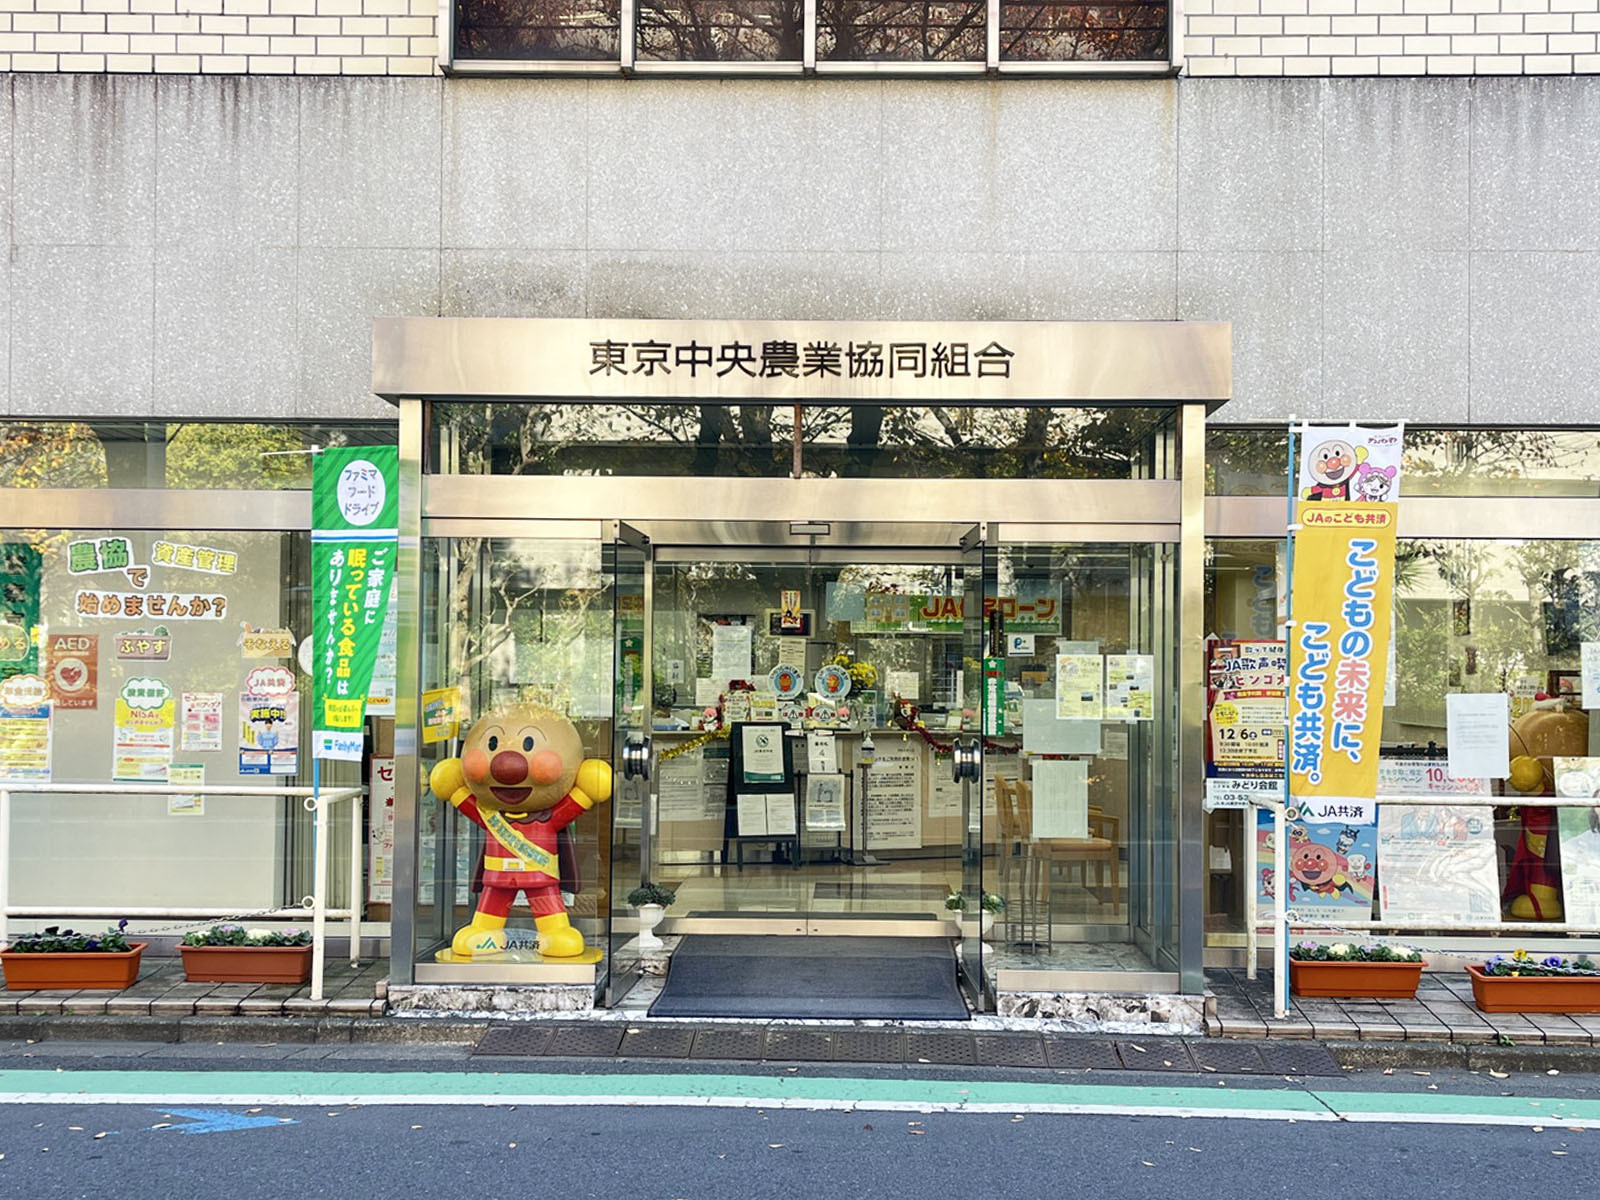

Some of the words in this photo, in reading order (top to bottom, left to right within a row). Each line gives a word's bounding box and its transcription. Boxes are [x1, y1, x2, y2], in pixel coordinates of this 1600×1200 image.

[589, 339, 1016, 378] 東京中央農業協同組合
[344, 468, 378, 481] ファミマ
[348, 485, 376, 498] フード
[344, 501, 380, 516] ドライブ
[1306, 512, 1387, 525] JAのこども共済
[69, 539, 130, 571] 農協
[154, 542, 237, 573] 資産管理
[127, 567, 149, 587] で
[363, 547, 389, 625] ご家庭に
[78, 592, 226, 617] 始めませんか?
[325, 549, 345, 684] ありませんか?
[336, 548, 367, 696] 眠っている食品は
[54, 637, 90, 650] AED
[120, 639, 166, 654] ふやす
[1332, 539, 1377, 761] こどもの未来に、
[1292, 624, 1331, 783] こども共済。
[1231, 780, 1278, 790] みどり会館
[1318, 805, 1364, 818] JA共済
[500, 940, 540, 950] JA共済
